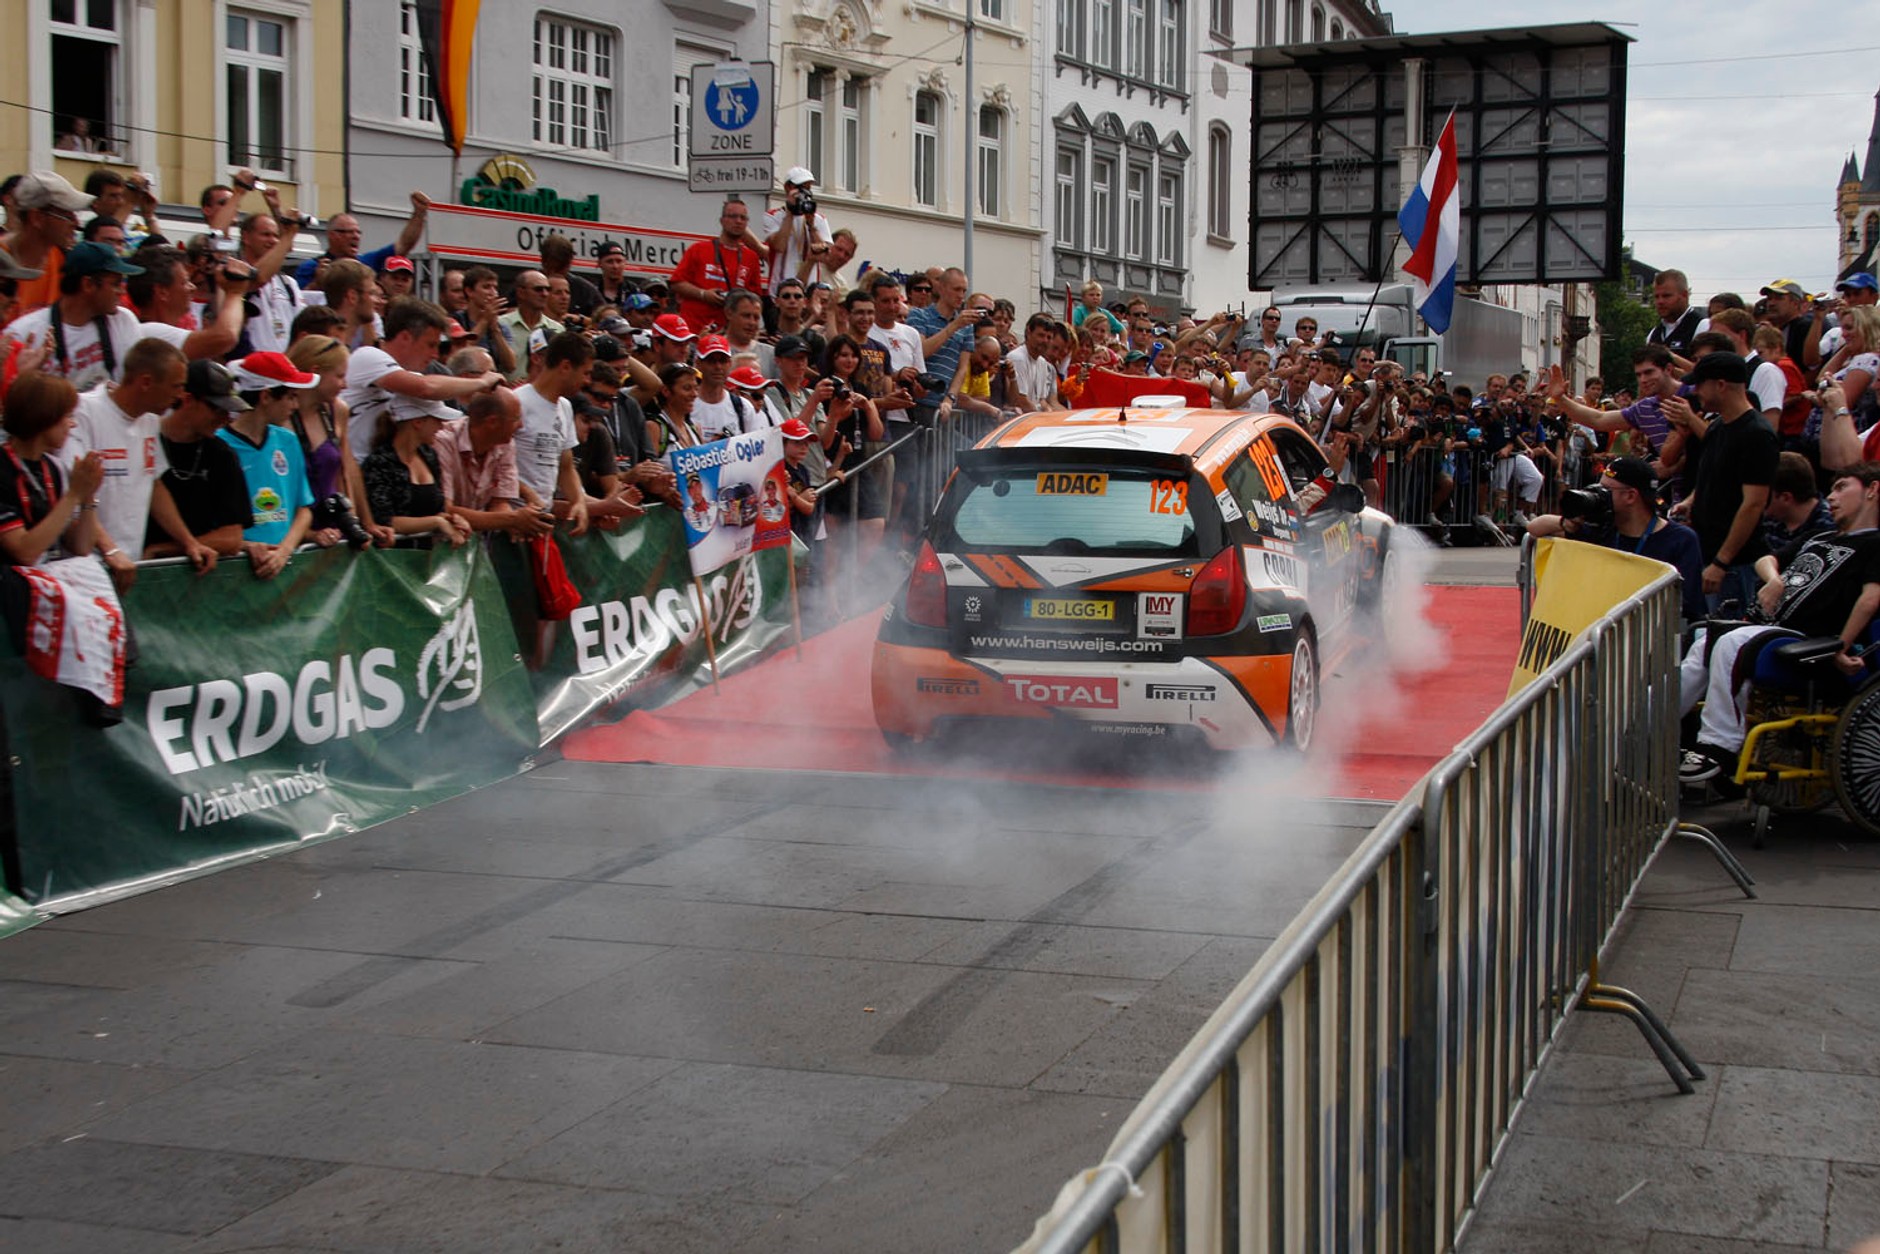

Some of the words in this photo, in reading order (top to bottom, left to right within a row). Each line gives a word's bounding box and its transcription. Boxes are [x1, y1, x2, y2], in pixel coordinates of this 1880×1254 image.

[710, 134, 752, 150] ZONE
[717, 168, 733, 180] frei
[517, 226, 611, 259] Ofcia
[1247, 438, 1287, 502] 123
[1041, 474, 1100, 494] ADAC
[1150, 479, 1188, 516] 123
[1037, 602, 1109, 617] 80-LGG-1
[970, 635, 1164, 653] www.hansweijs.com
[1007, 679, 1114, 704] TOTAL
[1145, 683, 1217, 702] PIRELLI
[146, 646, 405, 775] ERDGAS
[1090, 723, 1167, 738] www.myracing.be
